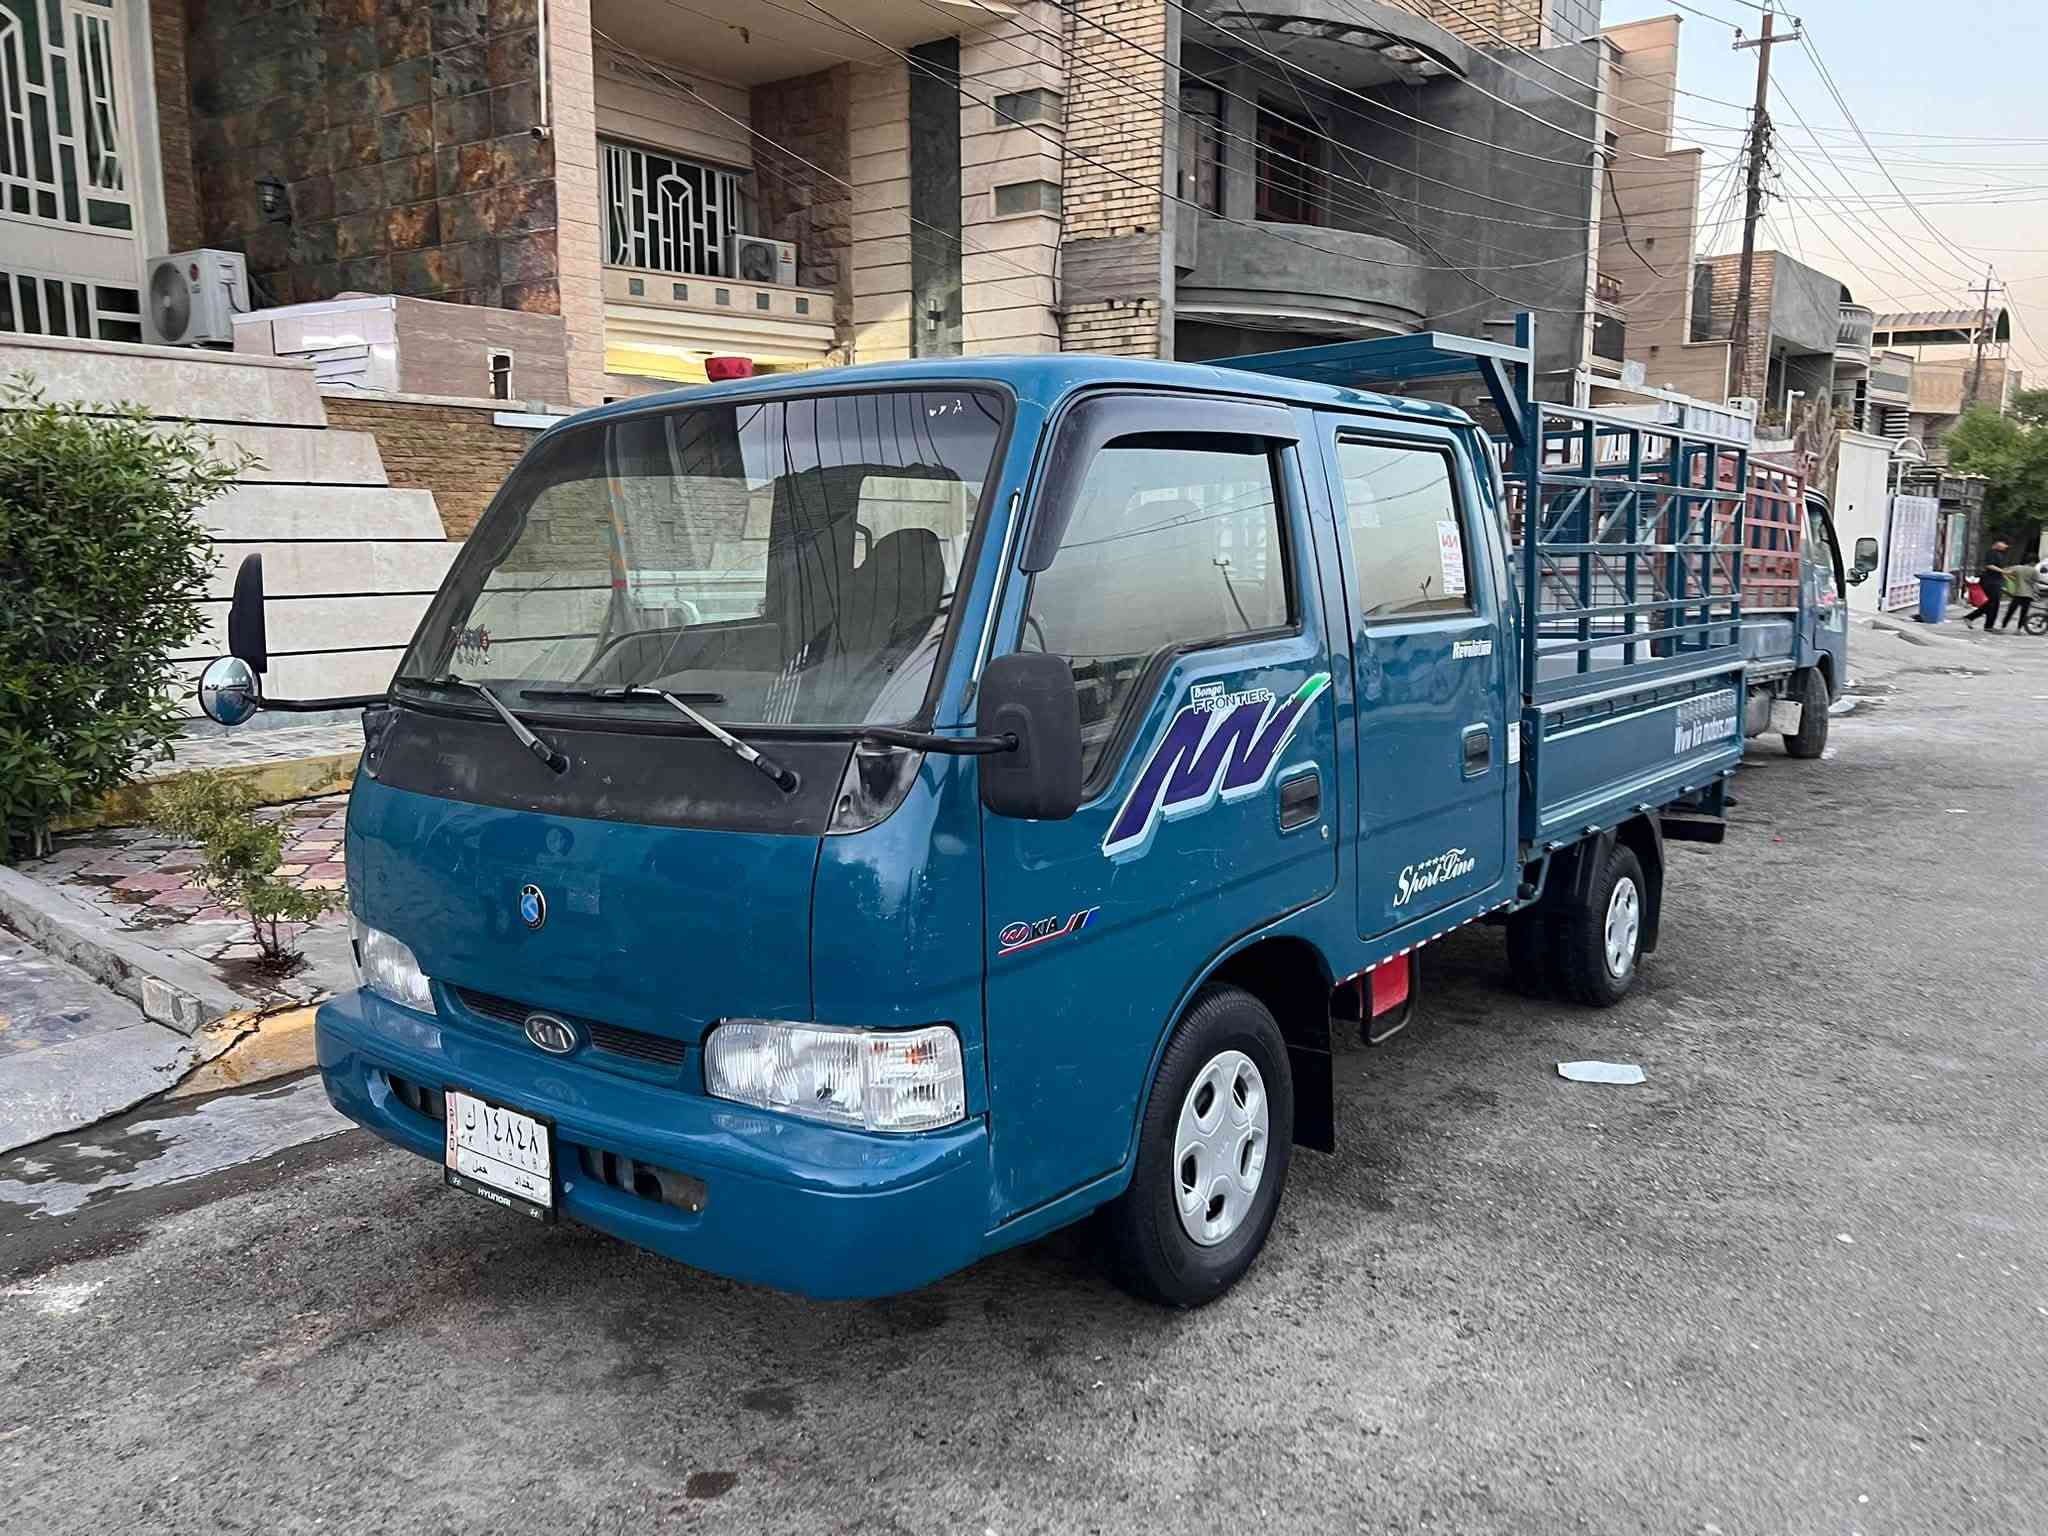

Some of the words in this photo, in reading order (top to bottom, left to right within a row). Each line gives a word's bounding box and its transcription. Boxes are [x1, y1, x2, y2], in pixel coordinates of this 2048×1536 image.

[1194, 688, 1271, 714] FRONTIER
[1440, 848, 1475, 882] Line
[484, 1107, 538, 1154] ١٤٨٤٨
[478, 1187, 513, 1208] HYUNDAI
